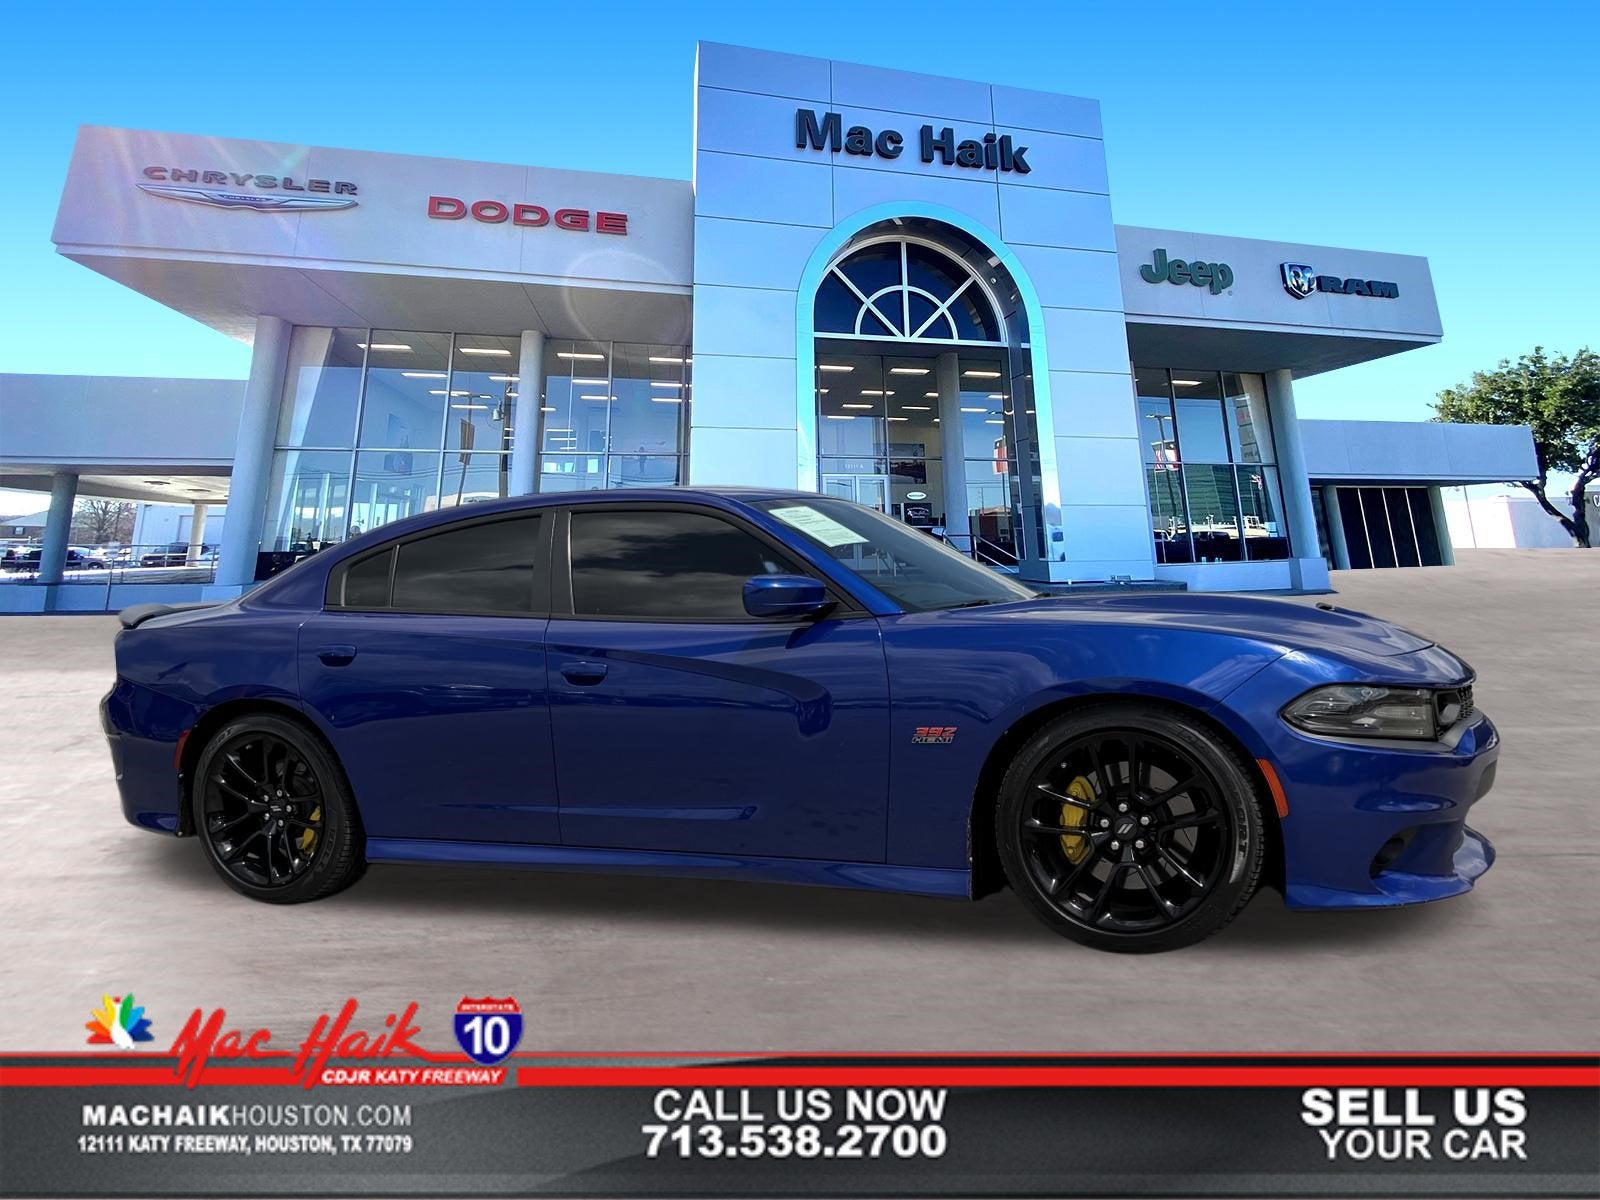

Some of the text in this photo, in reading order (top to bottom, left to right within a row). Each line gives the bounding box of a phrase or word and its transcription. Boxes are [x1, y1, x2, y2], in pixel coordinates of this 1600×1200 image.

[795, 108, 1032, 174] Mac Haik
[143, 166, 358, 196] CHRYSLER
[428, 196, 628, 236] DODGE
[1139, 248, 1234, 295] Jeep
[1316, 275, 1400, 299] RAM
[911, 736, 953, 744] HEMI
[913, 726, 957, 738] 392
